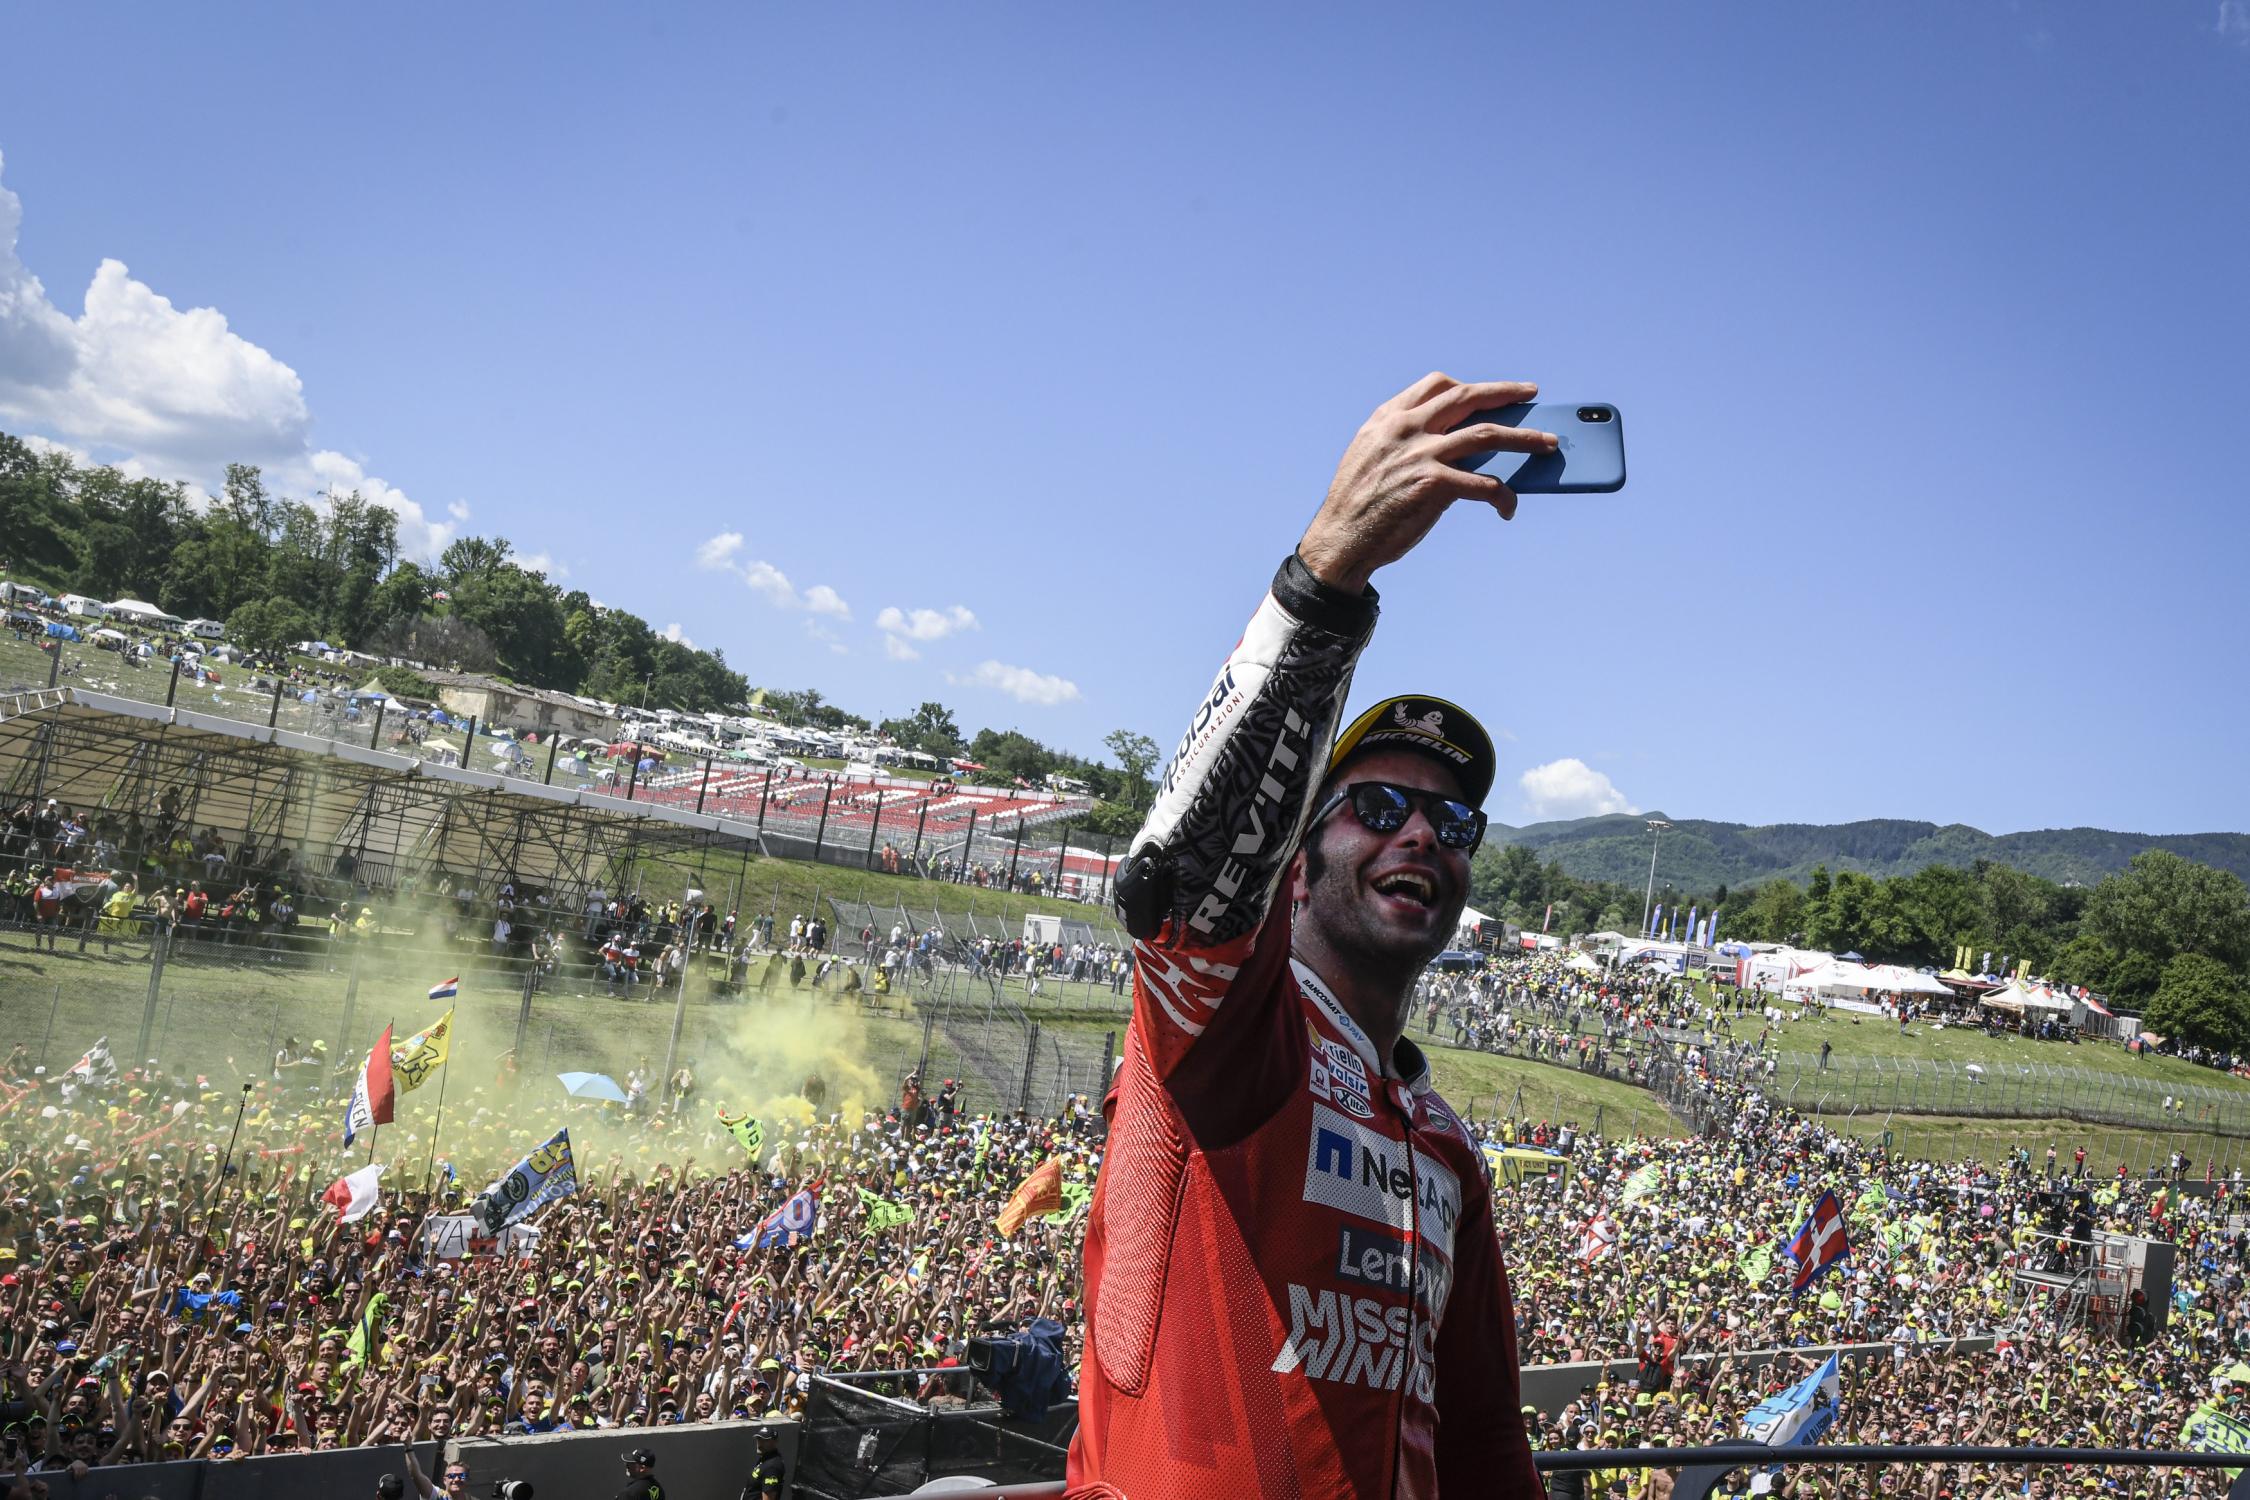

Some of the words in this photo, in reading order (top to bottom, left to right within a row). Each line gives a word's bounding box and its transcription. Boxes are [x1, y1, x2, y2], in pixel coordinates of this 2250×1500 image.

[1176, 691, 1245, 784] ASSICURAZIONI
[1359, 732, 1470, 764] MICHELIN
[1188, 706, 1312, 935] REV'IT!
[1302, 979, 1341, 1016] BANCOMAT
[1348, 1027, 1365, 1042] PAY
[1329, 1061, 1367, 1094] valsir
